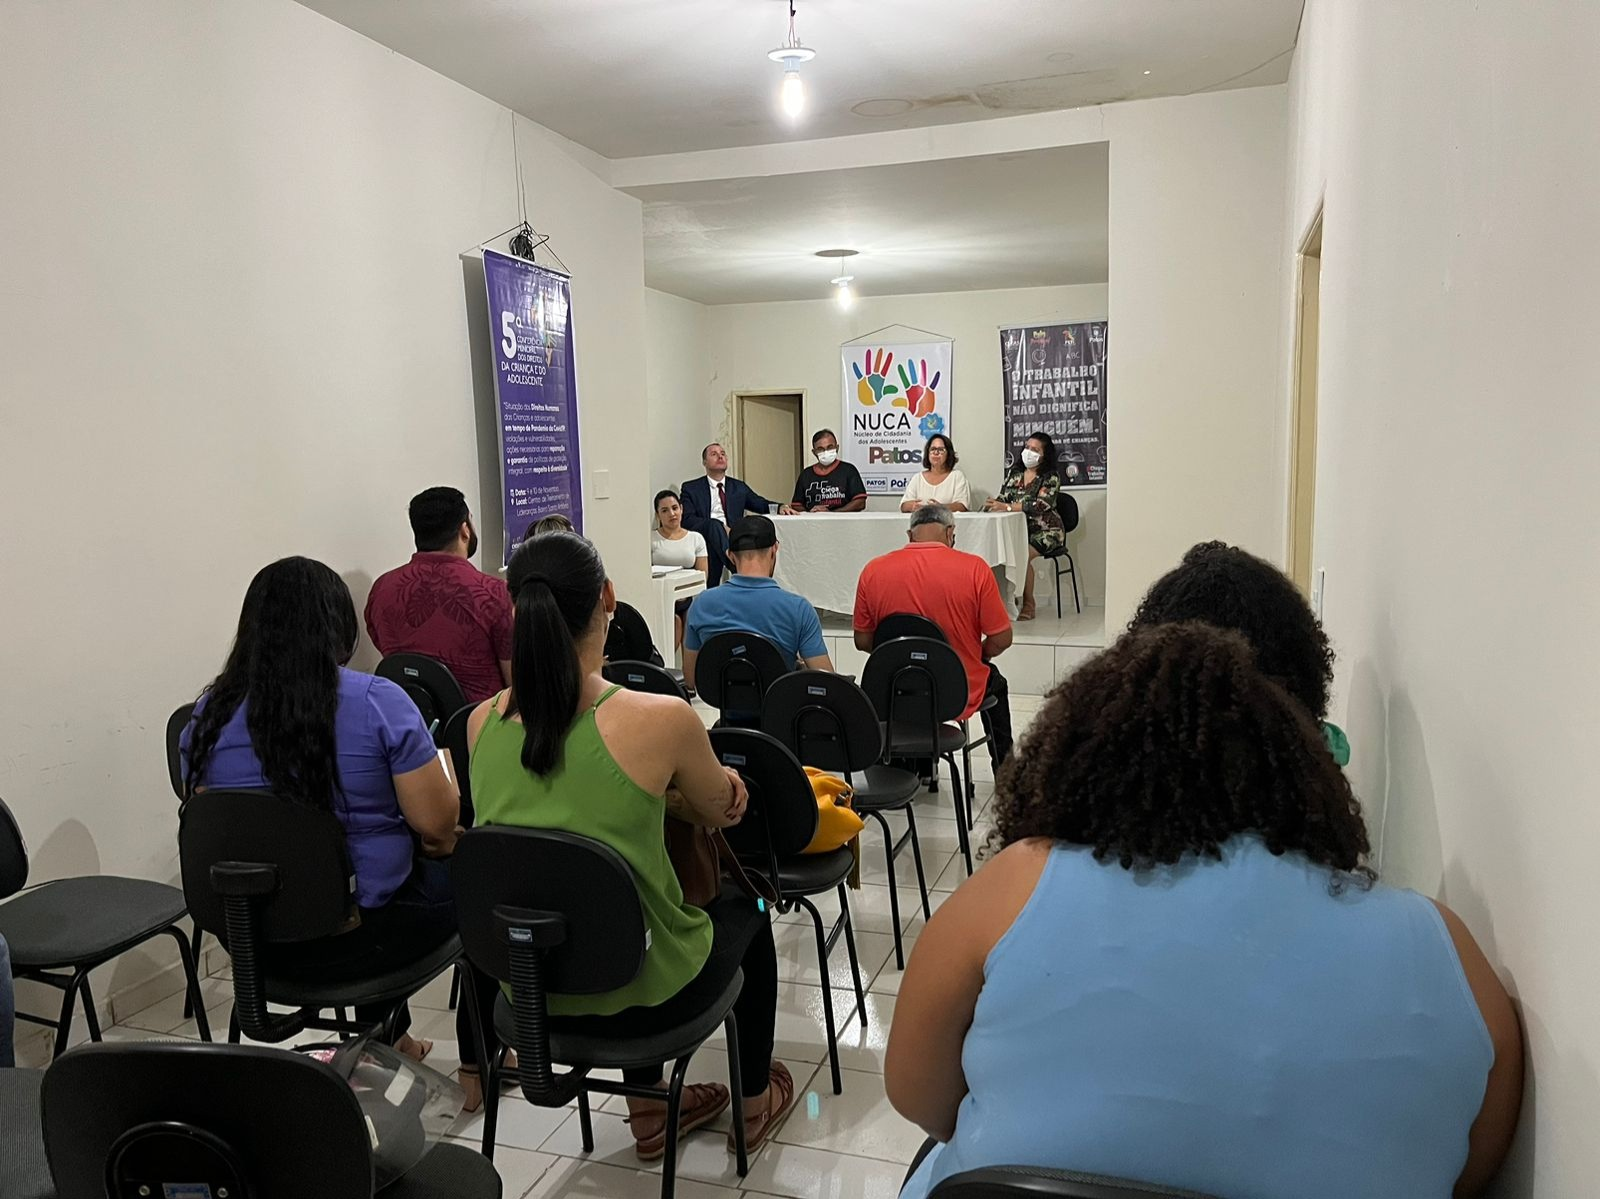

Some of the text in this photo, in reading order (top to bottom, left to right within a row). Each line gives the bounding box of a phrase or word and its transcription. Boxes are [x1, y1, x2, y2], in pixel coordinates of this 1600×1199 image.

[501, 361, 510, 371] DA
[511, 362, 534, 375] CRIANÇA
[538, 366, 547, 375] DO
[1025, 364, 1098, 381] TRABALHO
[507, 374, 543, 386] ADOLESCENTE
[1012, 380, 1098, 401] INFANTIL
[1012, 400, 1098, 416] NÃO DIGNIFICA
[854, 413, 911, 431] NUCA
[1013, 415, 1099, 438] NINGUÉM.
[869, 446, 922, 464] Patos
